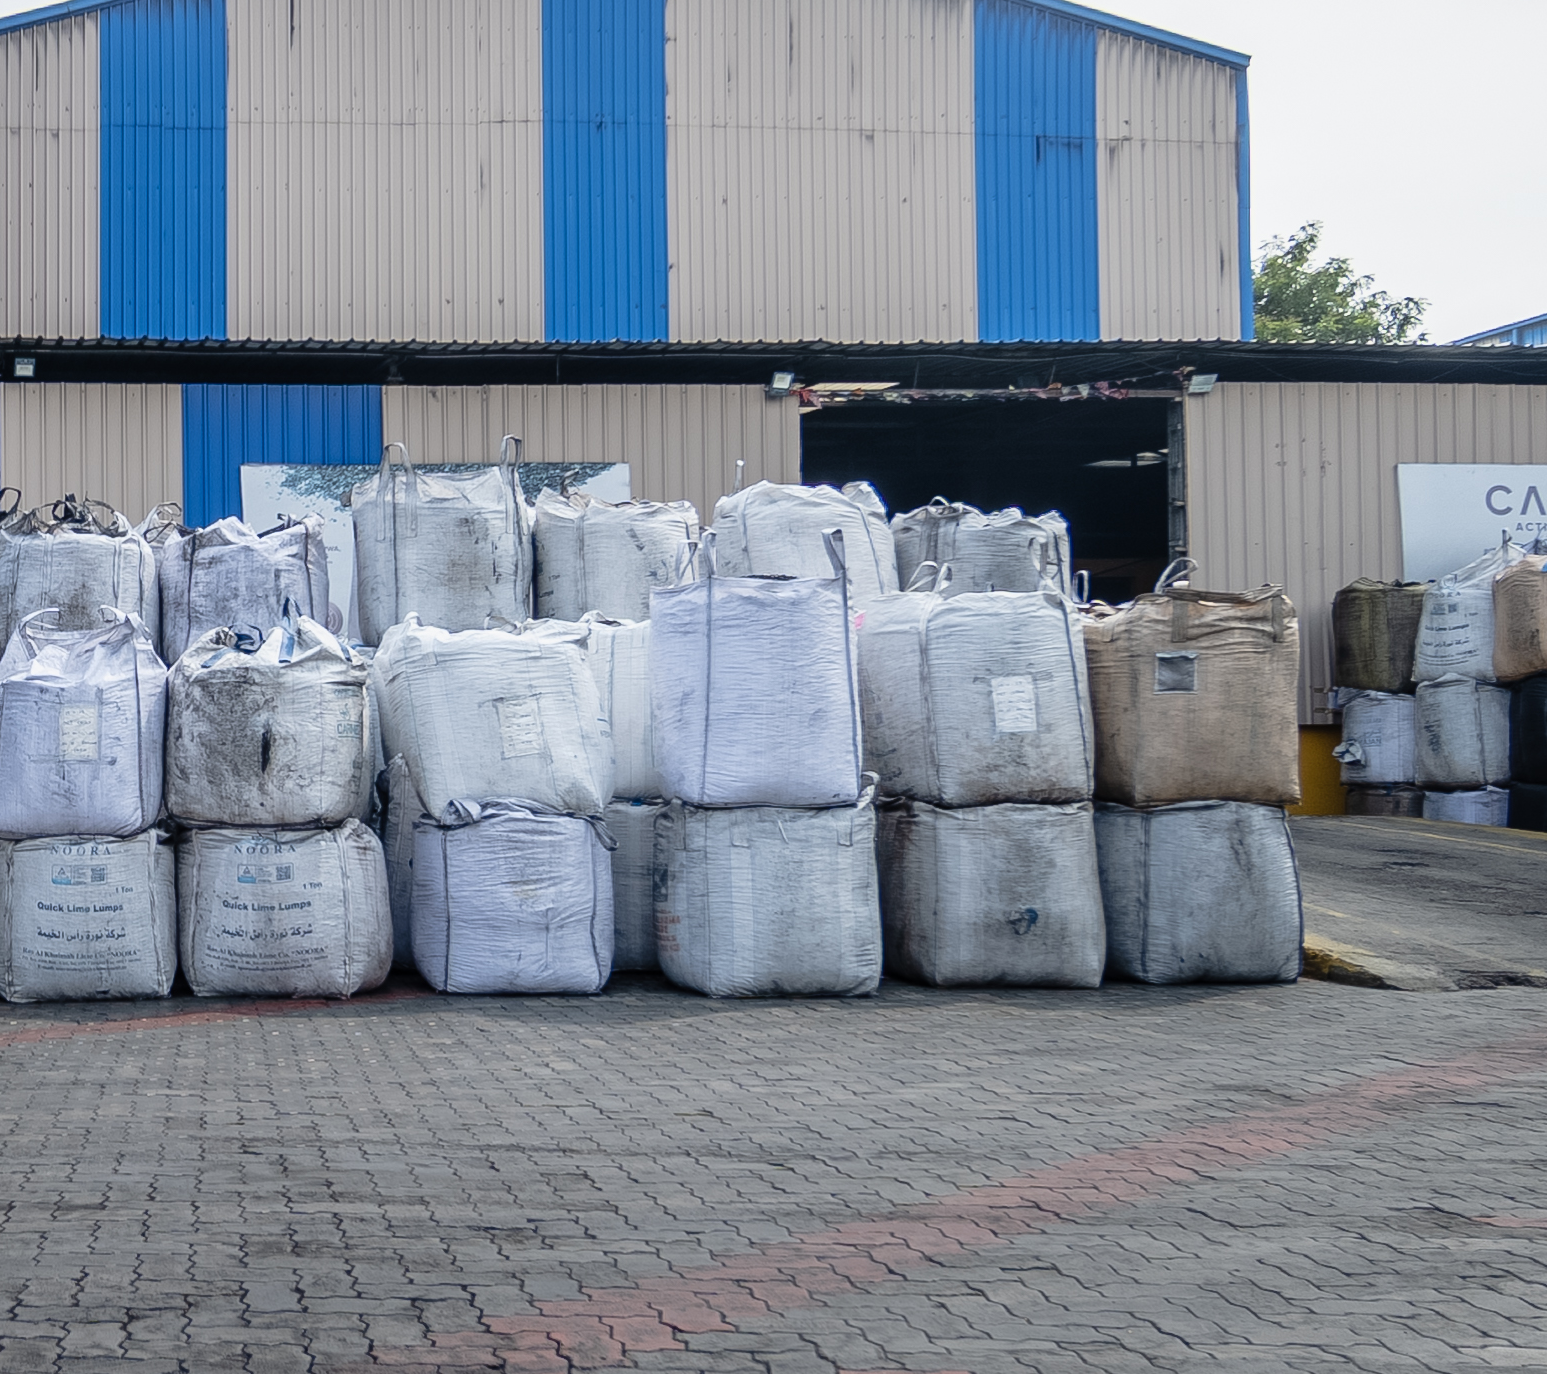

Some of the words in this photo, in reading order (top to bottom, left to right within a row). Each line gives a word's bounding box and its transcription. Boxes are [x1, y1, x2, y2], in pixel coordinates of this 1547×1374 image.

[50, 845, 111, 855] NOORA
[234, 845, 296, 855] NOORA
[37, 901, 64, 912] Quick
[67, 904, 90, 913] Lime
[93, 904, 123, 913] Lumps
[222, 900, 248, 911] Quick
[252, 903, 276, 911] Lime
[279, 900, 311, 911] Lumps
